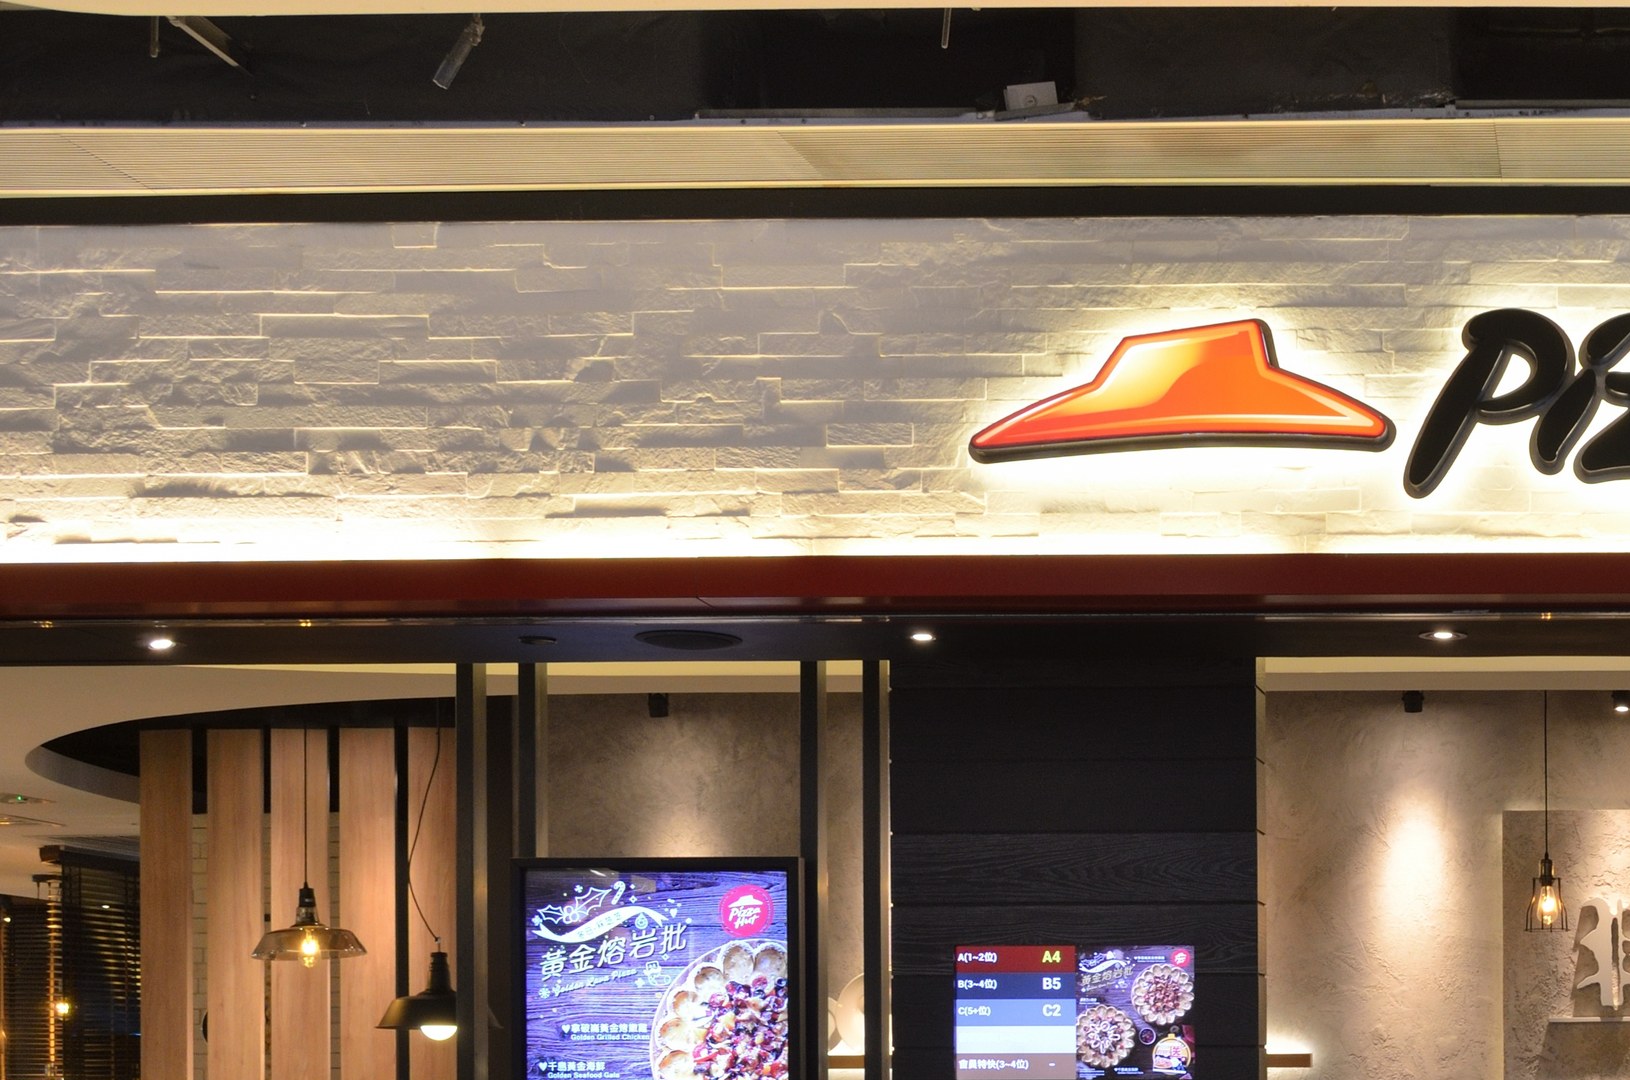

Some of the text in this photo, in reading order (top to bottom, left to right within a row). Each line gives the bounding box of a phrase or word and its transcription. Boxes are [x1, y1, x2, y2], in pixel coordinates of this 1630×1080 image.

[540, 922, 688, 981] 黃金熔岩批
[1042, 950, 1062, 963] A4
[1042, 977, 1062, 990] B5
[1042, 1004, 1062, 1017] C2
